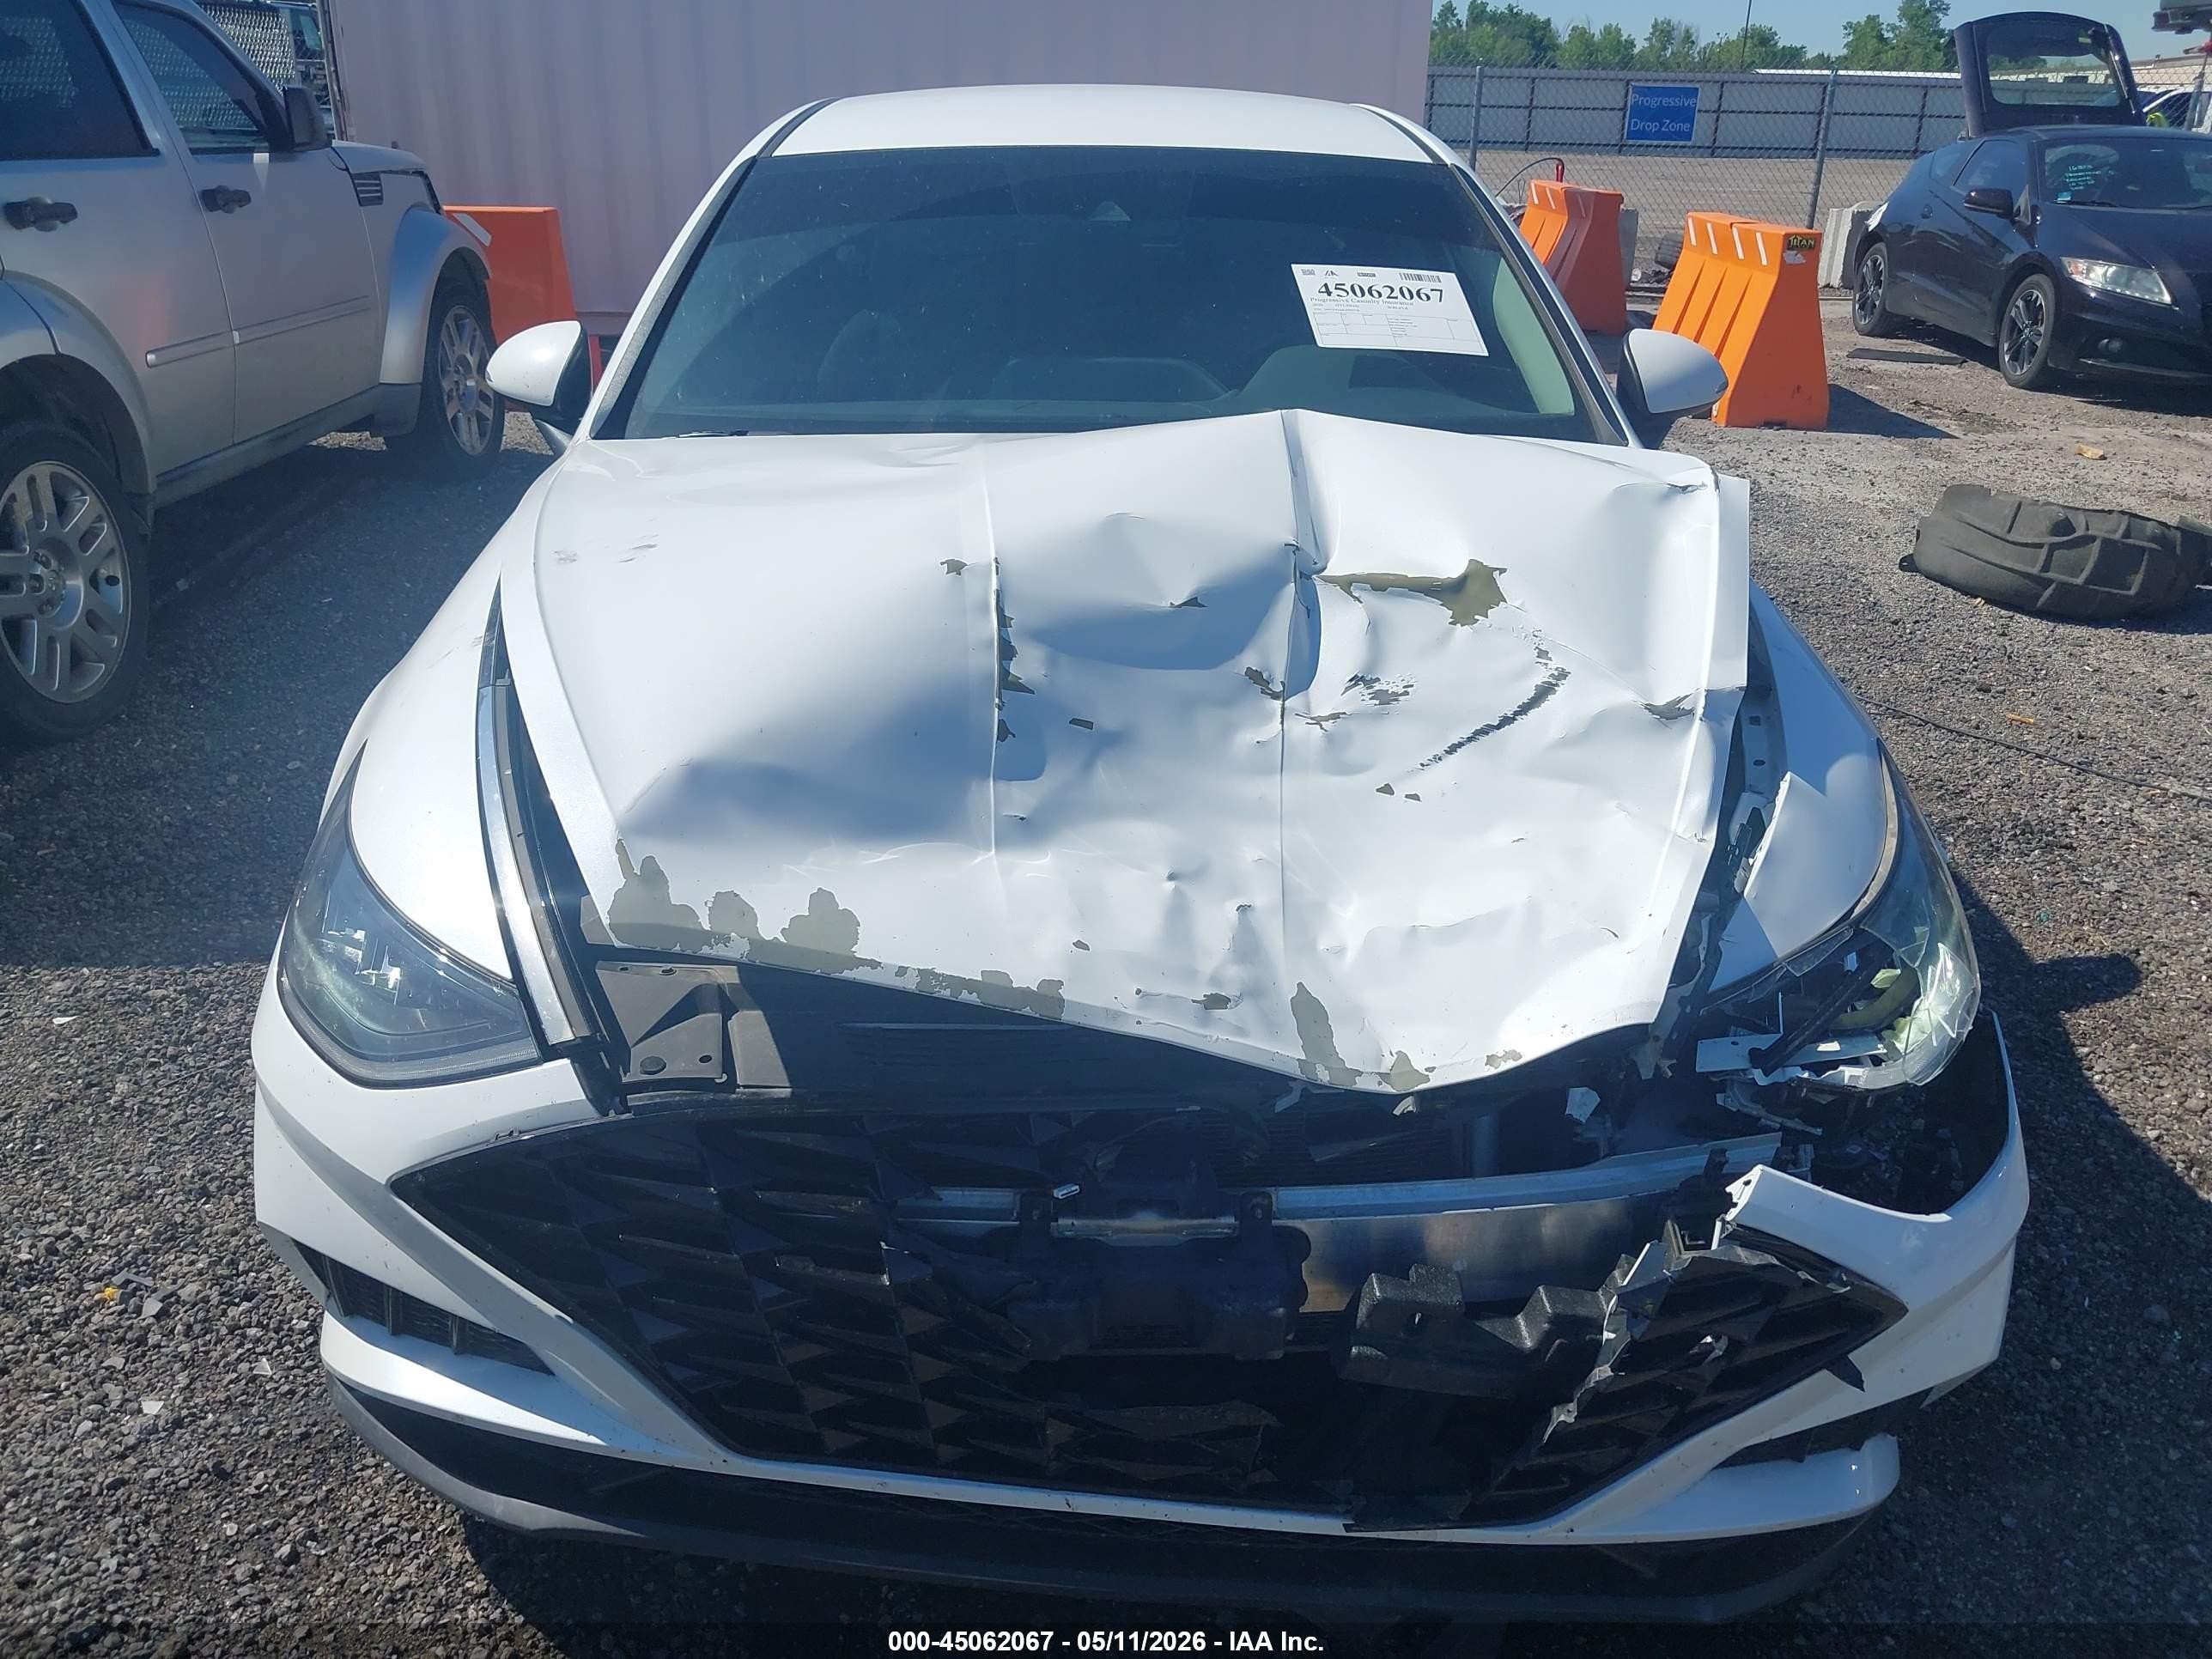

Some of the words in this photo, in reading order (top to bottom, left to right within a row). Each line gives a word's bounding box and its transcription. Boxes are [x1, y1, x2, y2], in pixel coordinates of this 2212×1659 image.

[1631, 94, 1698, 108] Progressive
[1631, 118, 1659, 133] Drop
[1662, 119, 1691, 131] Zone
[1789, 234, 1814, 248] TITAN
[1317, 282, 1443, 302] 45062067
